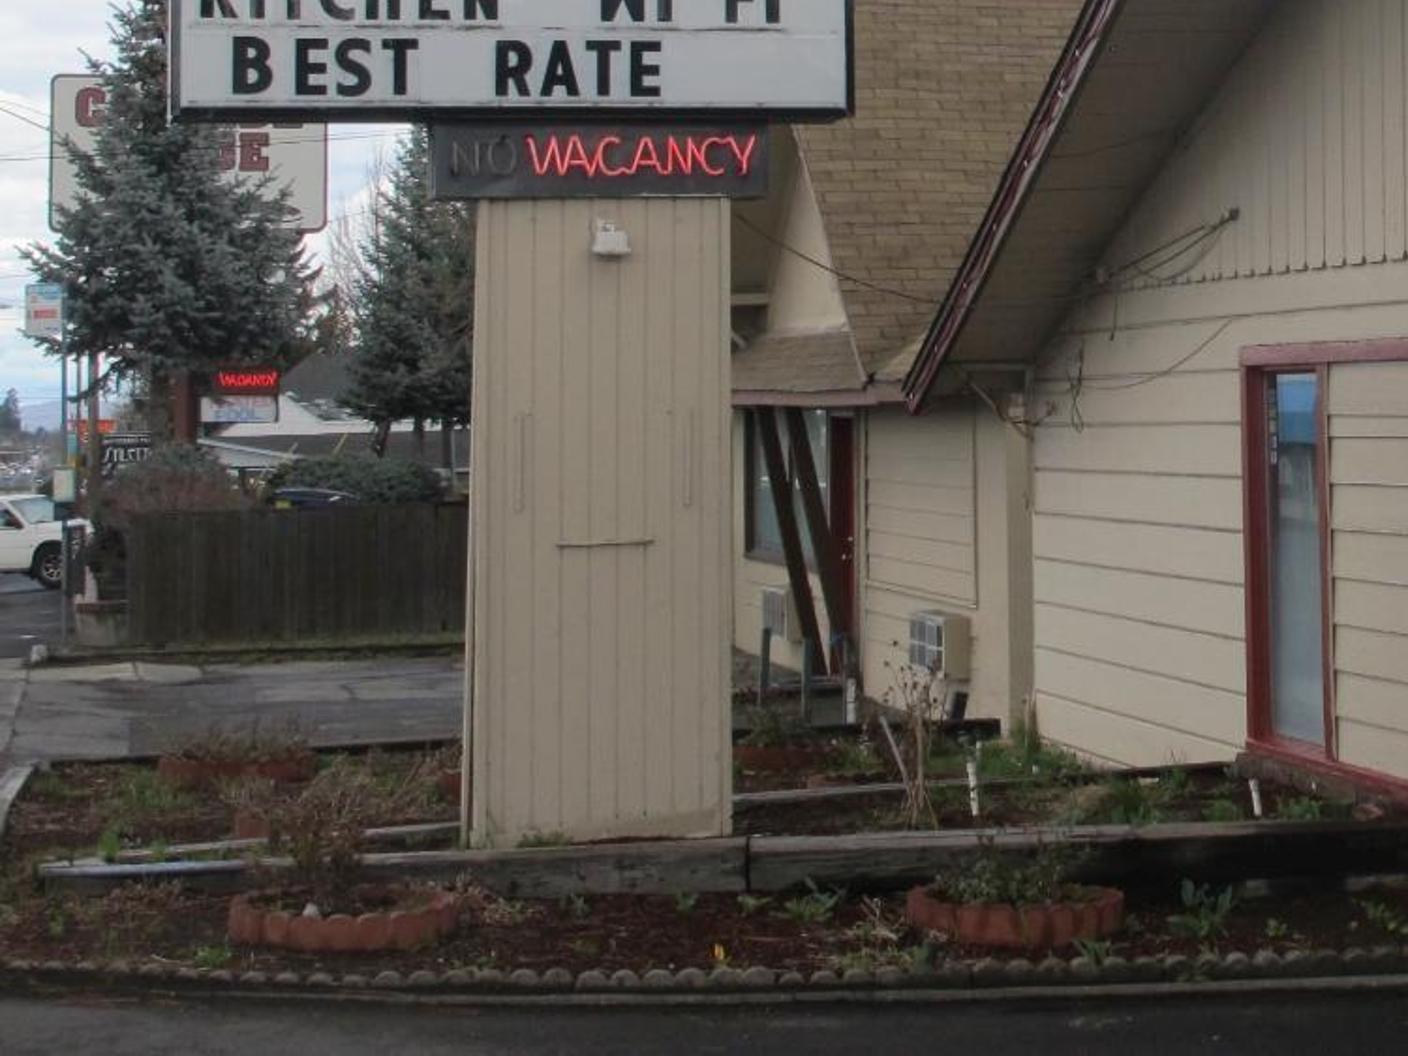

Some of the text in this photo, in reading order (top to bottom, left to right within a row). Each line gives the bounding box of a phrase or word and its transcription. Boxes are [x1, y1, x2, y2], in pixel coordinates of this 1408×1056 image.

[231, 36, 662, 98] BEST RATE
[451, 134, 756, 177] NO VACANCY
